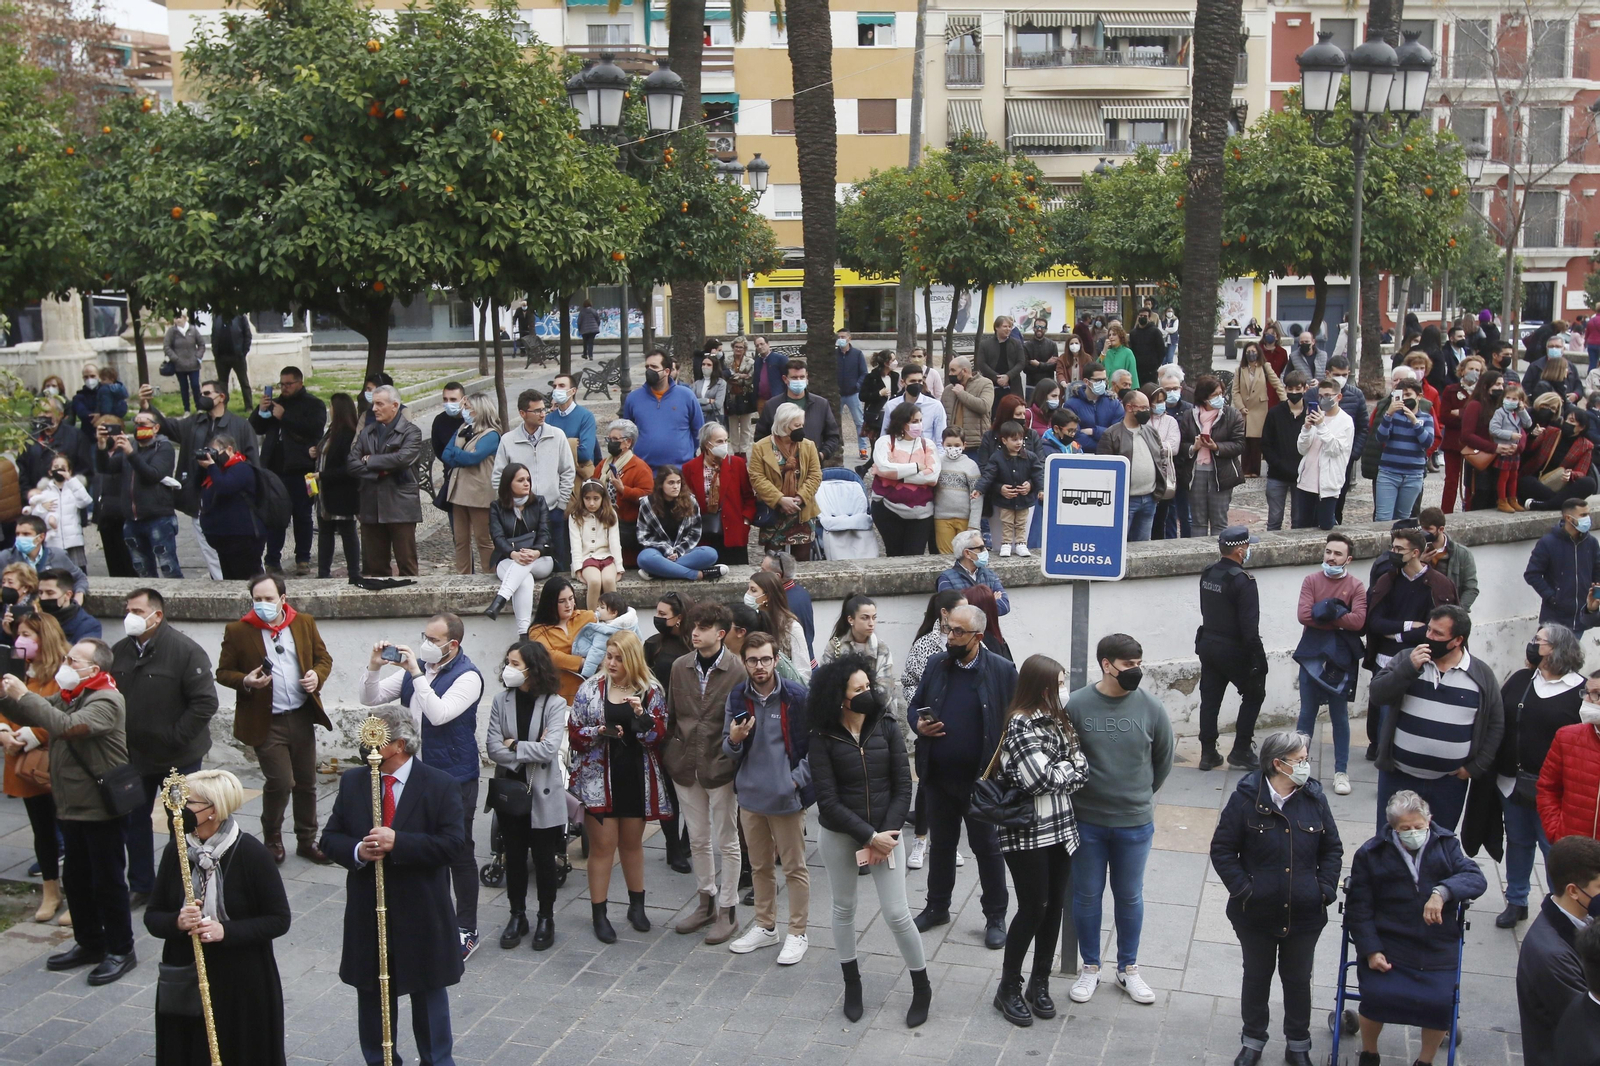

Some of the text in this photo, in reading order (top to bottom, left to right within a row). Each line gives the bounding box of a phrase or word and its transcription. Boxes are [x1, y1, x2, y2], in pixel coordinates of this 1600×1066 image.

[1072, 542, 1096, 552] BUS
[1054, 554, 1112, 565] AUCORSA
[1083, 717, 1144, 733] SILBON
